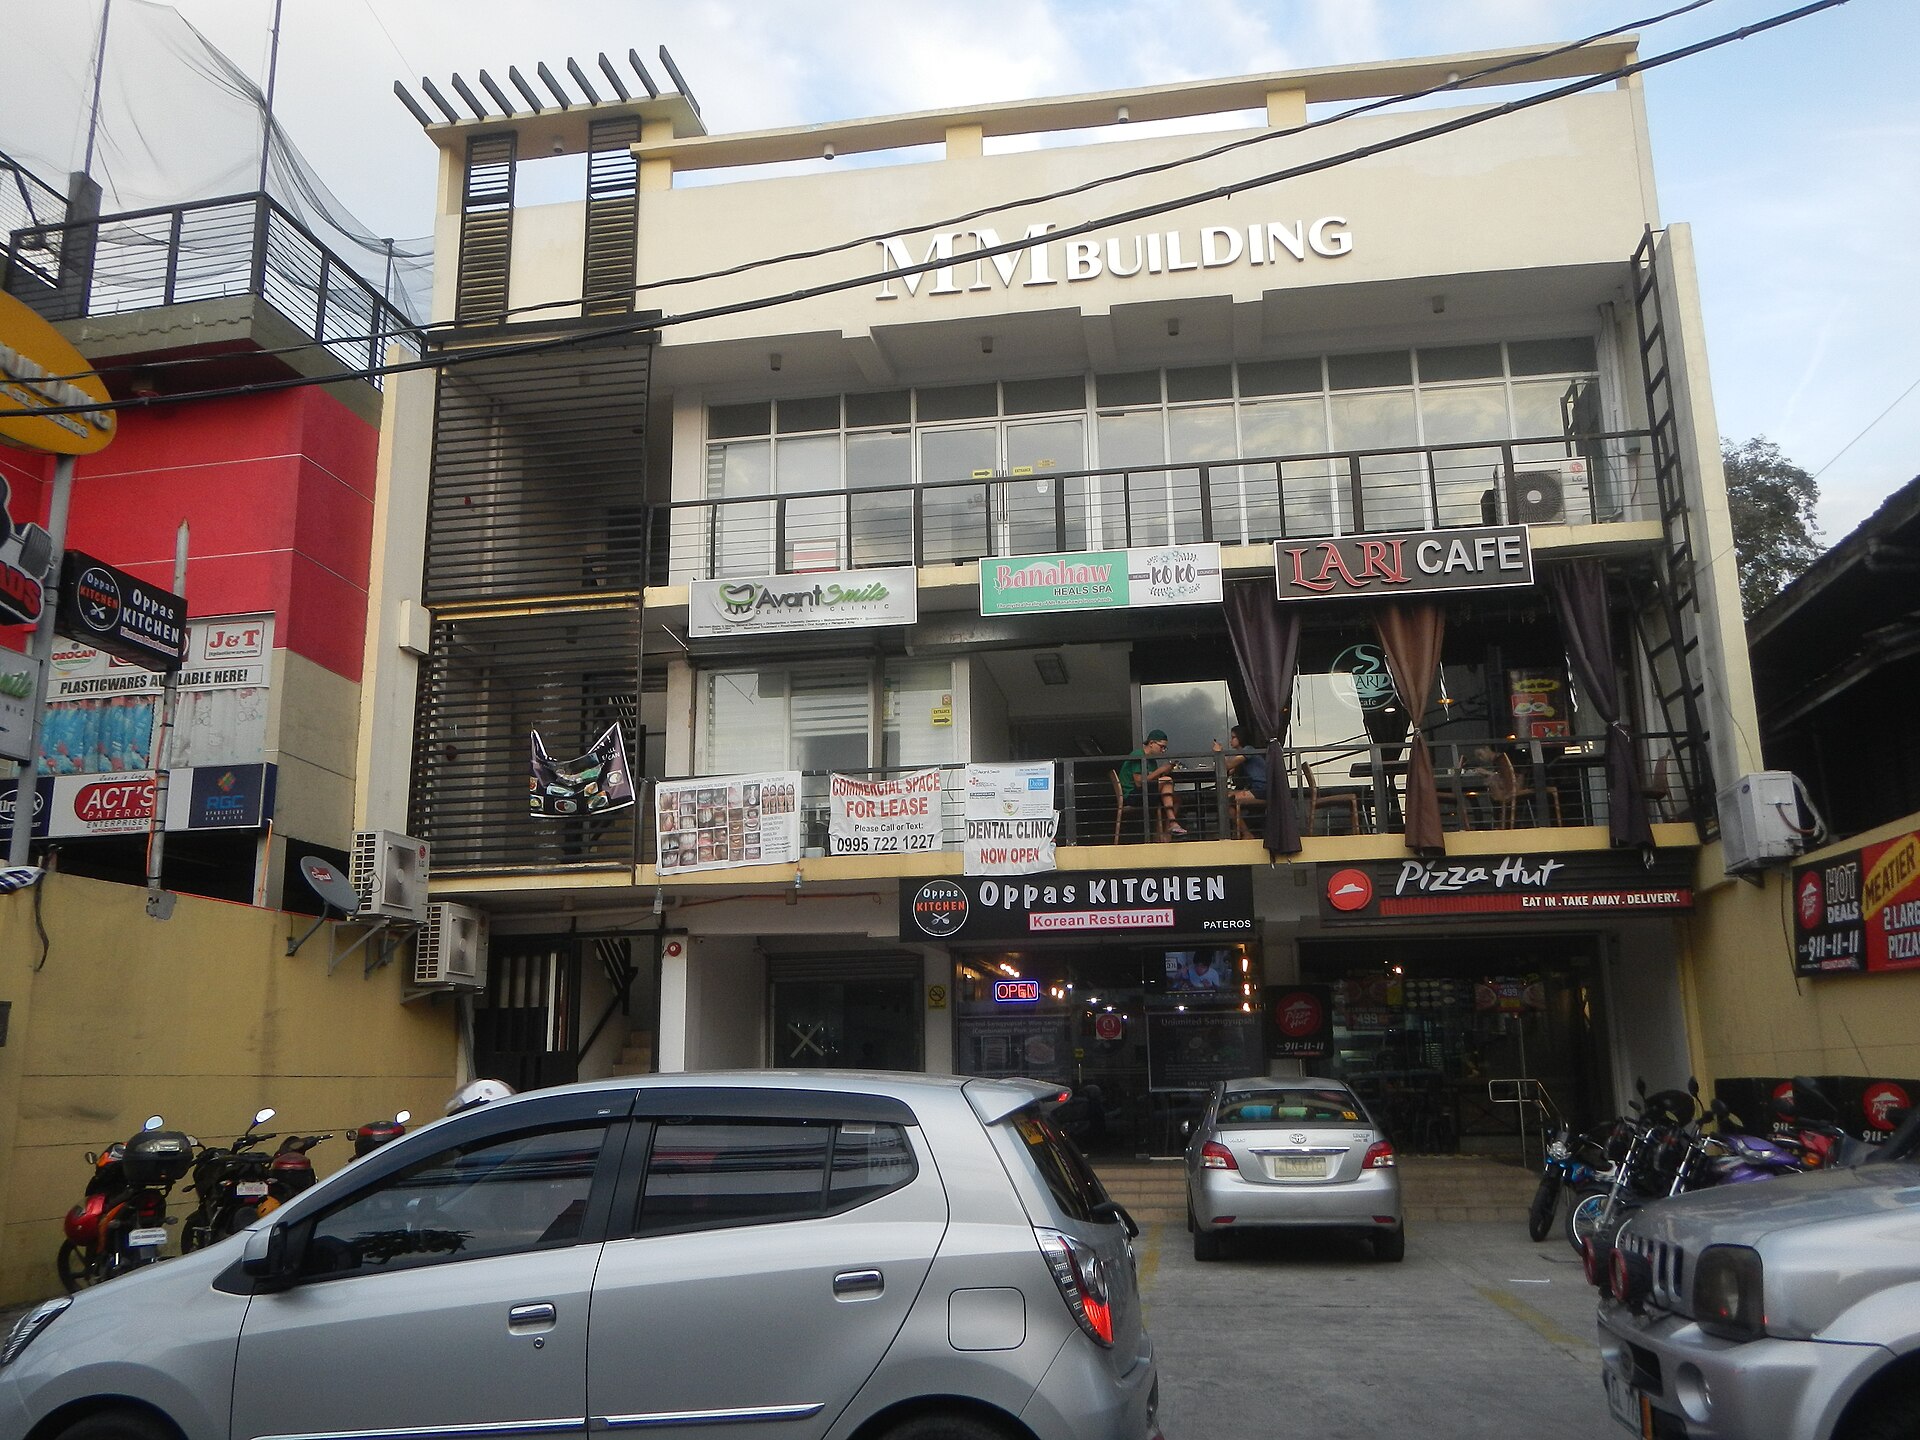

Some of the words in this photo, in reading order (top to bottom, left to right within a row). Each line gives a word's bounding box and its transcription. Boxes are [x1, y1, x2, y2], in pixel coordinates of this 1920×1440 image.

[1066, 215, 1353, 283] BUILDING
[1284, 539, 1412, 591] LARI
[1416, 535, 1524, 574] CAFE
[87, 572, 115, 593] Oppas
[996, 560, 1112, 589] Banahaw
[80, 585, 118, 609] KITCHEN
[756, 585, 822, 609] Avant
[821, 582, 889, 605] Smile
[1054, 586, 1089, 596] HEALS
[1092, 585, 1113, 594] SPA
[132, 589, 174, 620] Oppas
[756, 606, 815, 615] DENTAL
[830, 603, 890, 612] CLINIC
[122, 607, 180, 643] KITCHEN
[209, 630, 260, 648] J&T
[60, 675, 148, 694] PLASTICWARES
[214, 669, 248, 683] HERE!
[832, 776, 903, 797] COMMERCIAL
[905, 772, 940, 793] SPACE
[82, 785, 154, 814] ACT'S
[845, 799, 876, 819] FOR
[880, 796, 929, 817] LEASE
[86, 818, 149, 829] ENTERPRISES
[87, 808, 151, 819] PATEROS
[854, 823, 879, 833] Please
[880, 823, 895, 832] Call
[896, 824, 905, 832] or
[905, 822, 924, 831] Text:
[968, 821, 1013, 840] DENTAL
[1016, 819, 1055, 839] CLINIC
[836, 836, 869, 852] 0995
[873, 835, 899, 851] 722
[902, 833, 935, 850] 1227
[980, 848, 1007, 864] NOW
[1010, 847, 1040, 863] OPEN
[1395, 859, 1489, 896] Pizza
[1492, 856, 1564, 888] Hut
[1825, 862, 1857, 904] HOT
[1864, 842, 1917, 911] MEATIER
[922, 888, 959, 900] Oppas
[979, 879, 1076, 910] Oppas
[1088, 875, 1226, 904] KITCHEN
[1522, 896, 1542, 907] EAT
[1544, 895, 1556, 906] IN
[916, 900, 966, 912] KITCHEN
[1827, 901, 1859, 924] DEALS
[1033, 913, 1085, 928] Korean
[1089, 910, 1170, 926] Restaurant
[1203, 919, 1251, 930] PATEROS
[1883, 907, 1891, 930] 2
[1808, 929, 1859, 961] 911-11-11
[997, 983, 1037, 999] OPEN
[1160, 1017, 1202, 1026] Unlimited
[1284, 1041, 1325, 1051] 911-11-11
